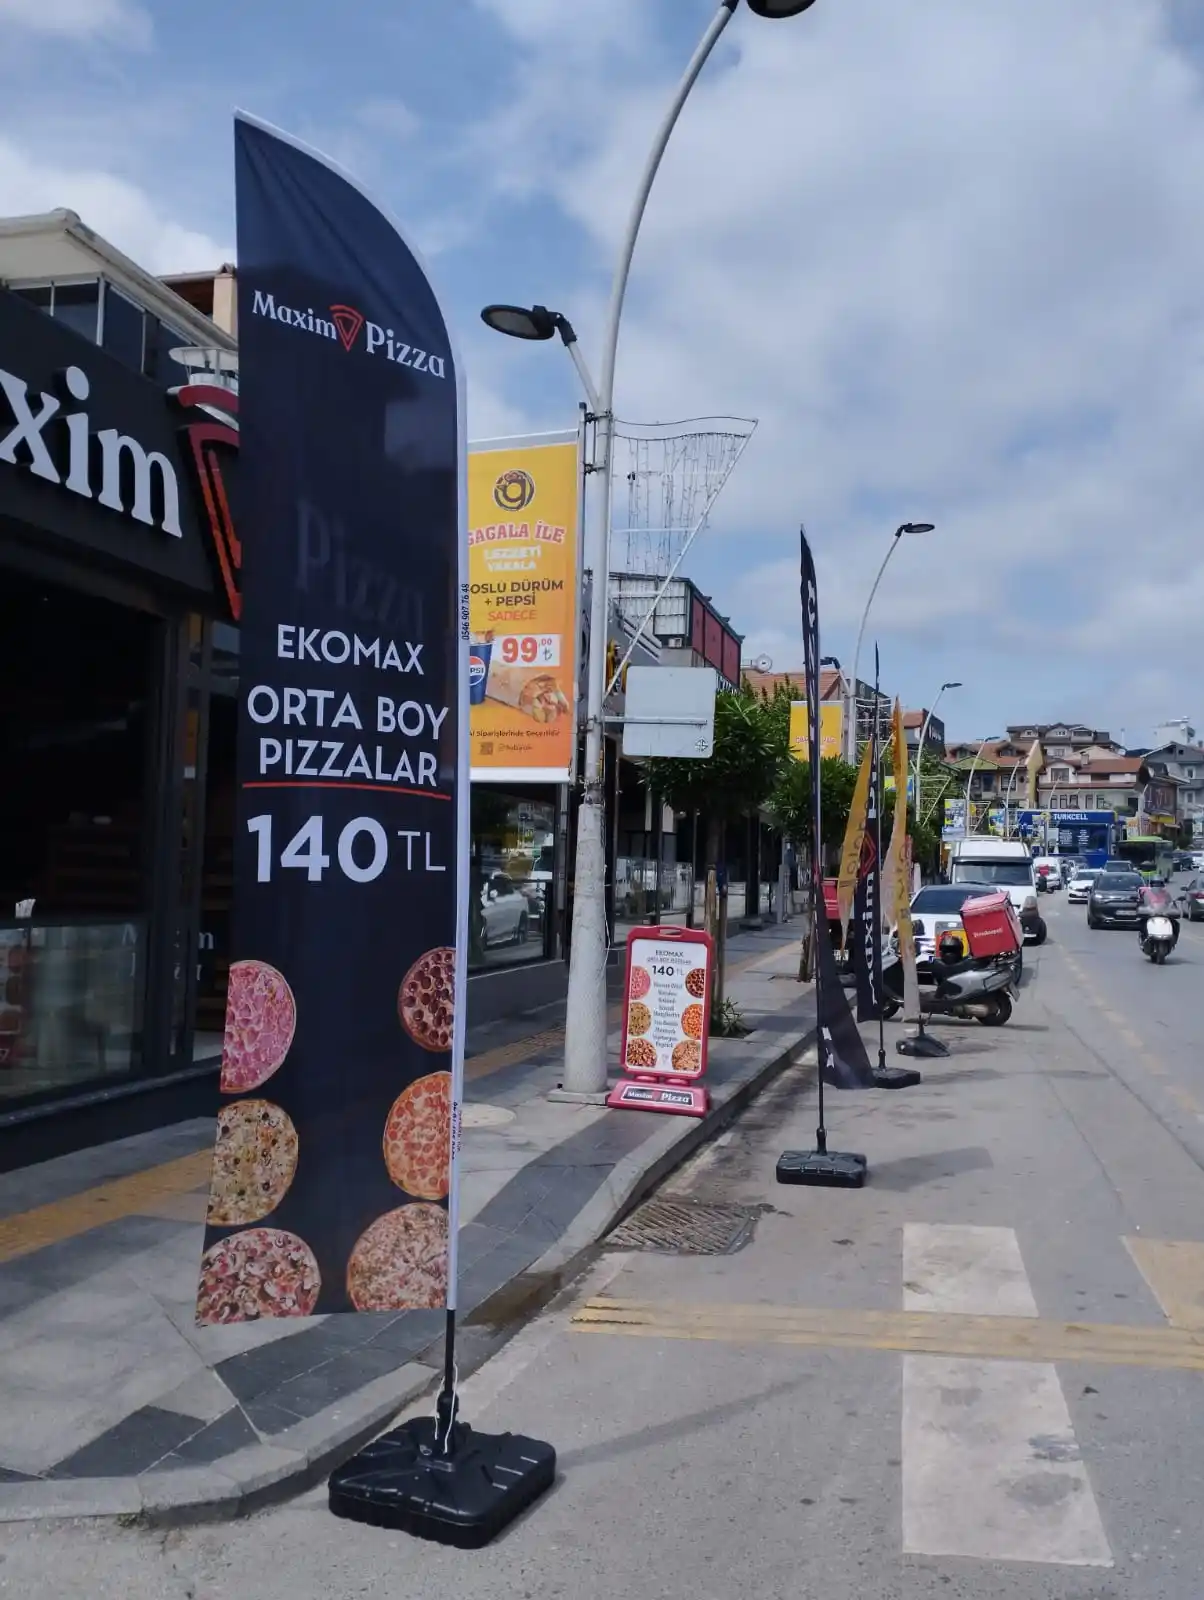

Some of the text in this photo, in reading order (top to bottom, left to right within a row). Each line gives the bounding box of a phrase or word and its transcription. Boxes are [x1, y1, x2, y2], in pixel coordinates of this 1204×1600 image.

[252, 290, 446, 379] Maxim Pizza
[511, 576, 563, 593] DÜRÜM
[488, 609, 538, 622] SADECE
[277, 624, 424, 675] EKOMAX
[247, 685, 449, 740] ORTA BOY
[259, 737, 437, 787] PIZZALAR
[247, 814, 446, 883] 140 TL
[652, 965, 674, 977] 140
[661, 1092, 689, 1103] Pizza
